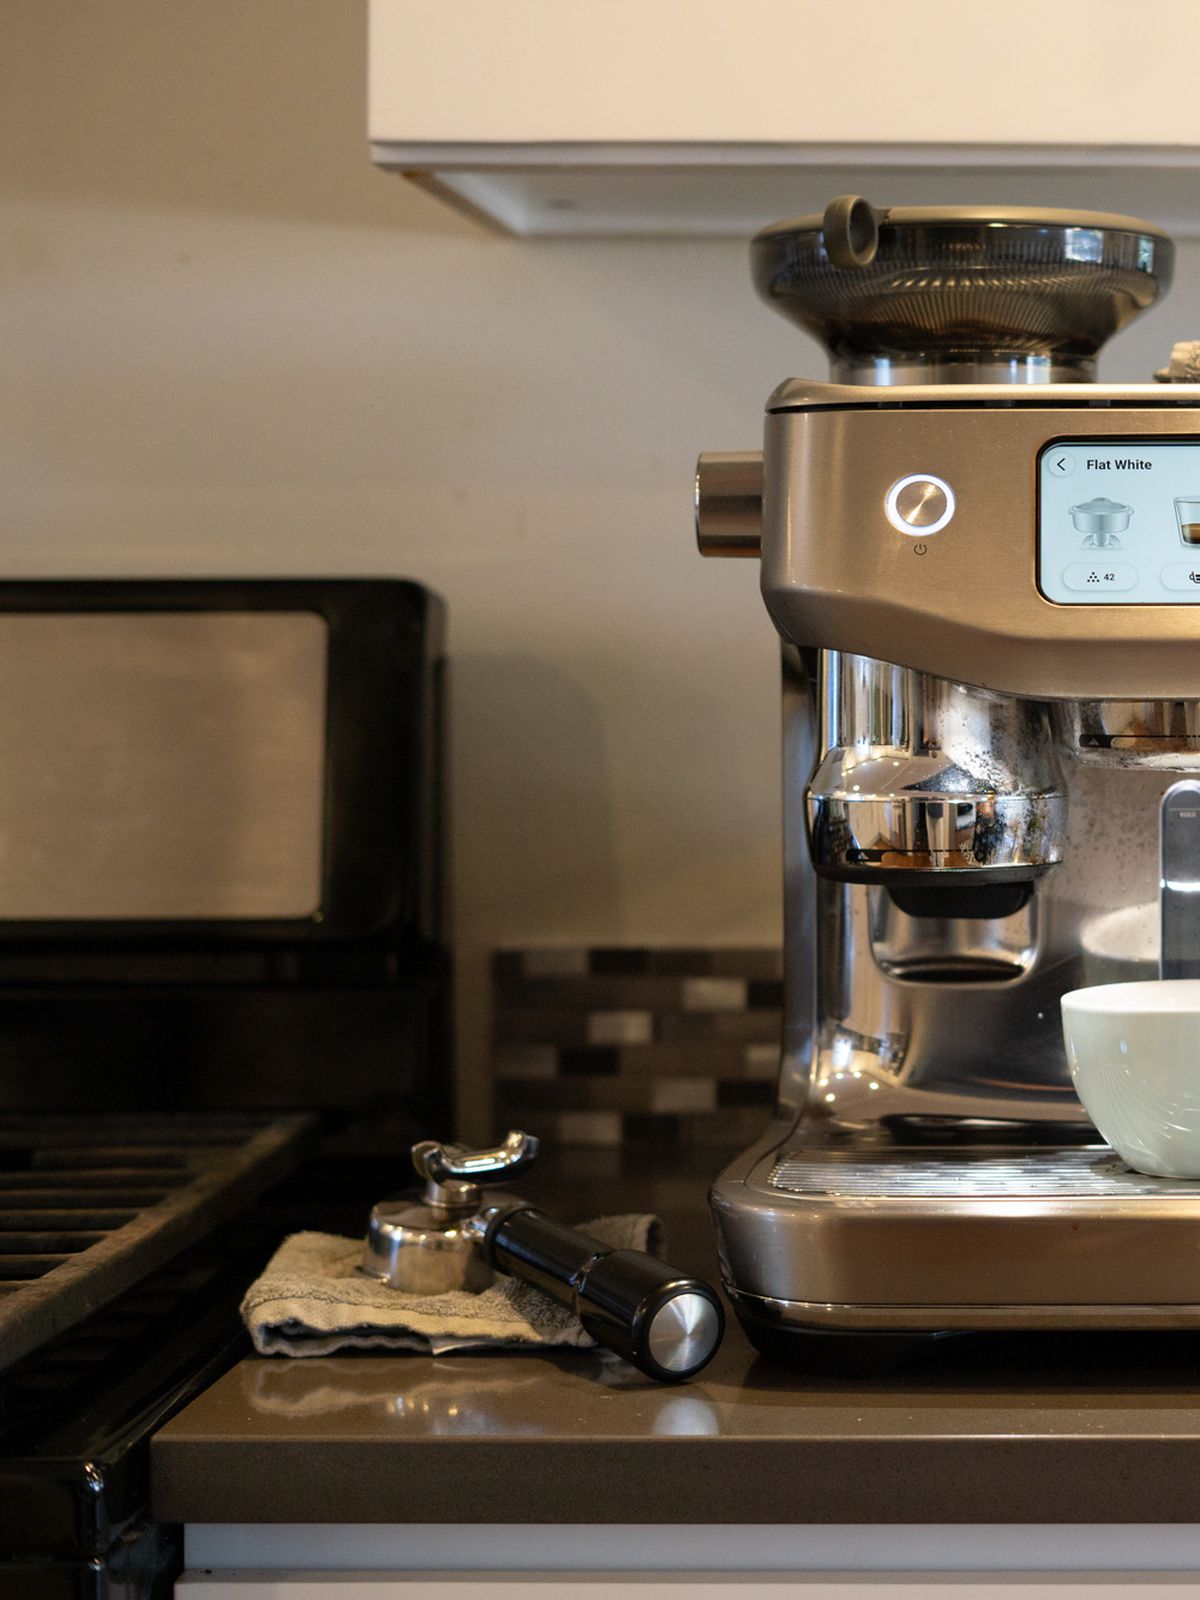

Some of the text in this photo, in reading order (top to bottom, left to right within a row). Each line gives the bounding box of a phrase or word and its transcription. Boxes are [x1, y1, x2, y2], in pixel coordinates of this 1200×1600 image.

[1086, 459, 1152, 470] Flat White
[1103, 573, 1115, 581] 42
